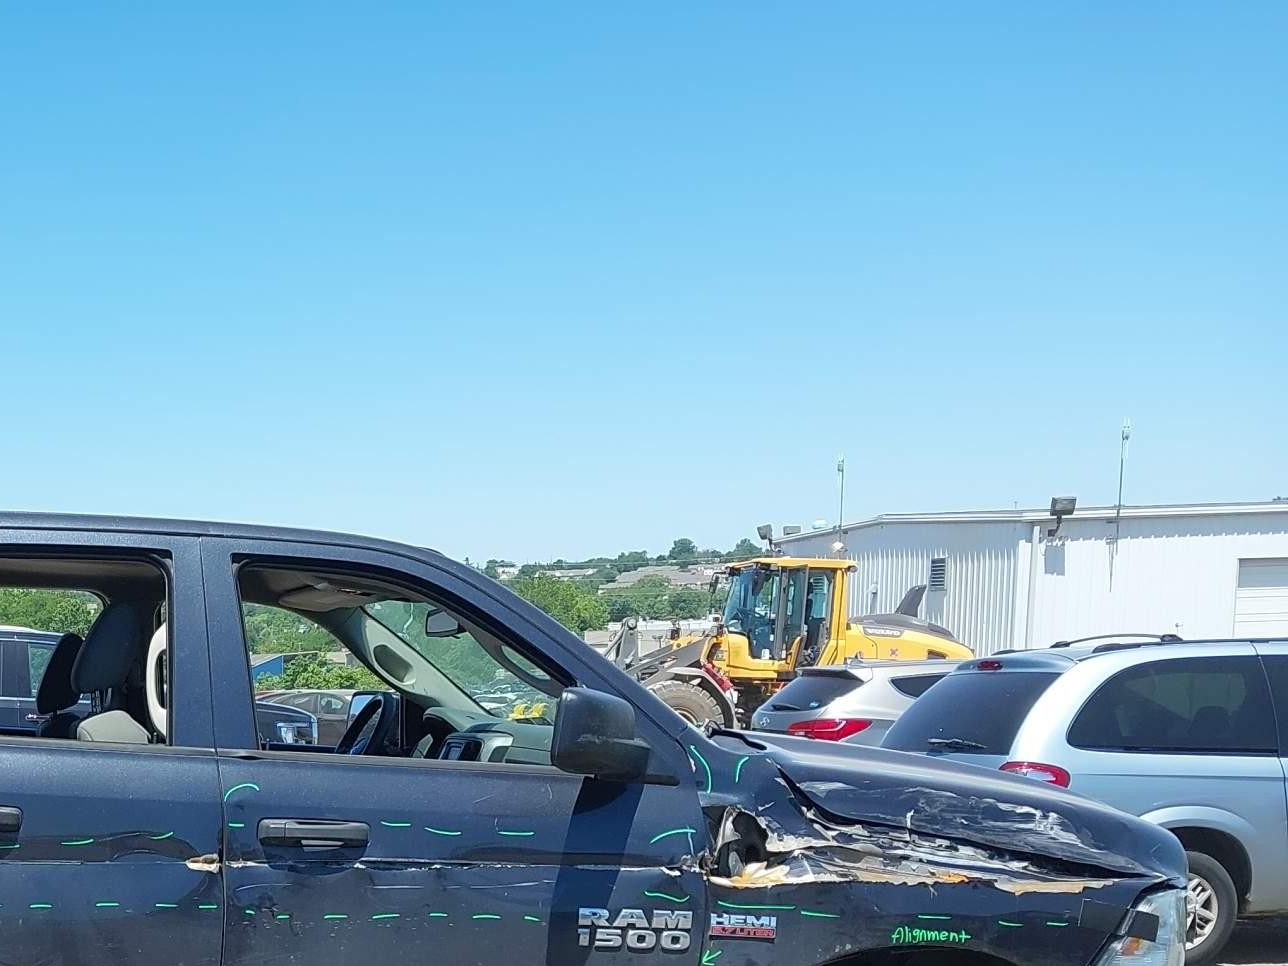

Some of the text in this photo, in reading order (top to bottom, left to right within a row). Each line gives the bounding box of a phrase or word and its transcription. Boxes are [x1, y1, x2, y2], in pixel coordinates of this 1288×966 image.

[578, 907, 693, 929] RAM
[711, 913, 776, 927] HEMI
[577, 928, 691, 950] 1500
[891, 926, 971, 944] Alignment
